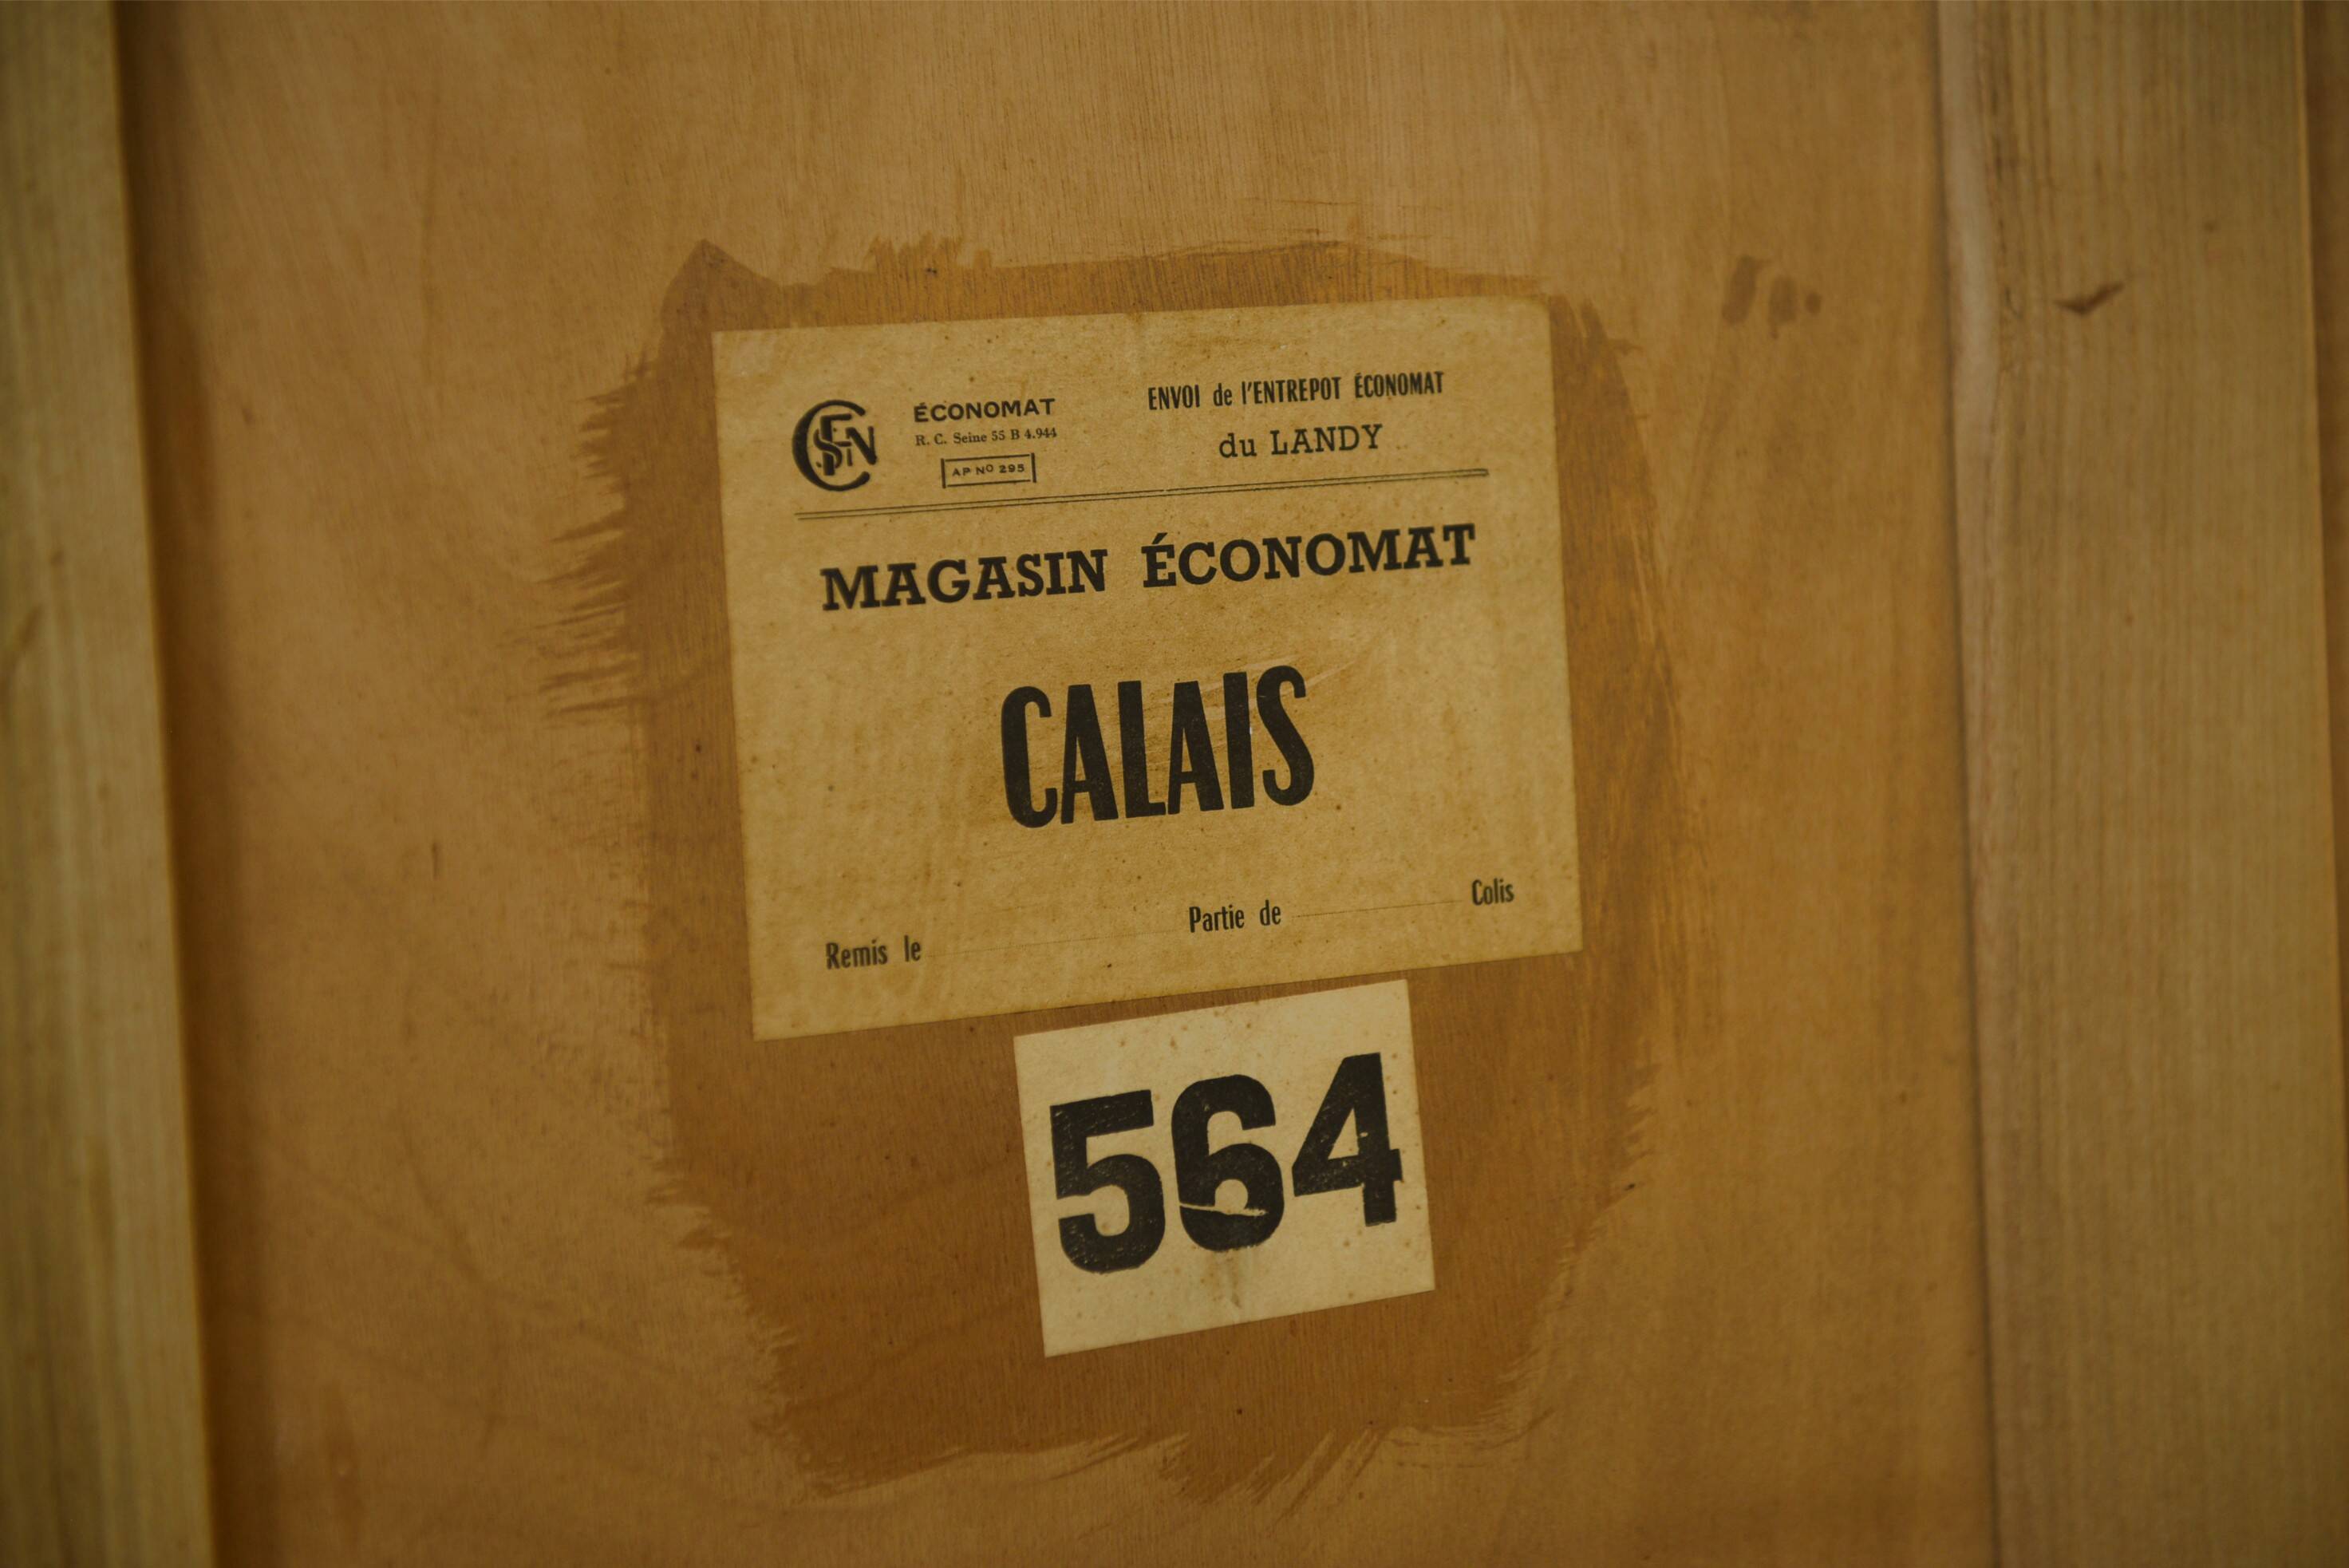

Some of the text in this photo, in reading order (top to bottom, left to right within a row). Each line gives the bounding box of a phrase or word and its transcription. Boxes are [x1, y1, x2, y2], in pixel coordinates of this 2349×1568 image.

[913, 397, 1056, 423] ÉCONOMAT
[1147, 384, 1201, 411] ENVOI
[1213, 382, 1233, 407] de
[1354, 370, 1444, 399] ÉCONOMAT
[915, 427, 1057, 447] R. C. Seine 55 B 4.944
[1218, 423, 1383, 459] du LANDY
[952, 467, 971, 476] AP
[998, 463, 1025, 474] 295
[819, 523, 1475, 612] MAGASIN ÉCONOMAT
[1000, 665, 1315, 829] CALAIS
[825, 878, 1514, 970] Remis le Partie de Colis
[1049, 1052, 1404, 1275] 564
